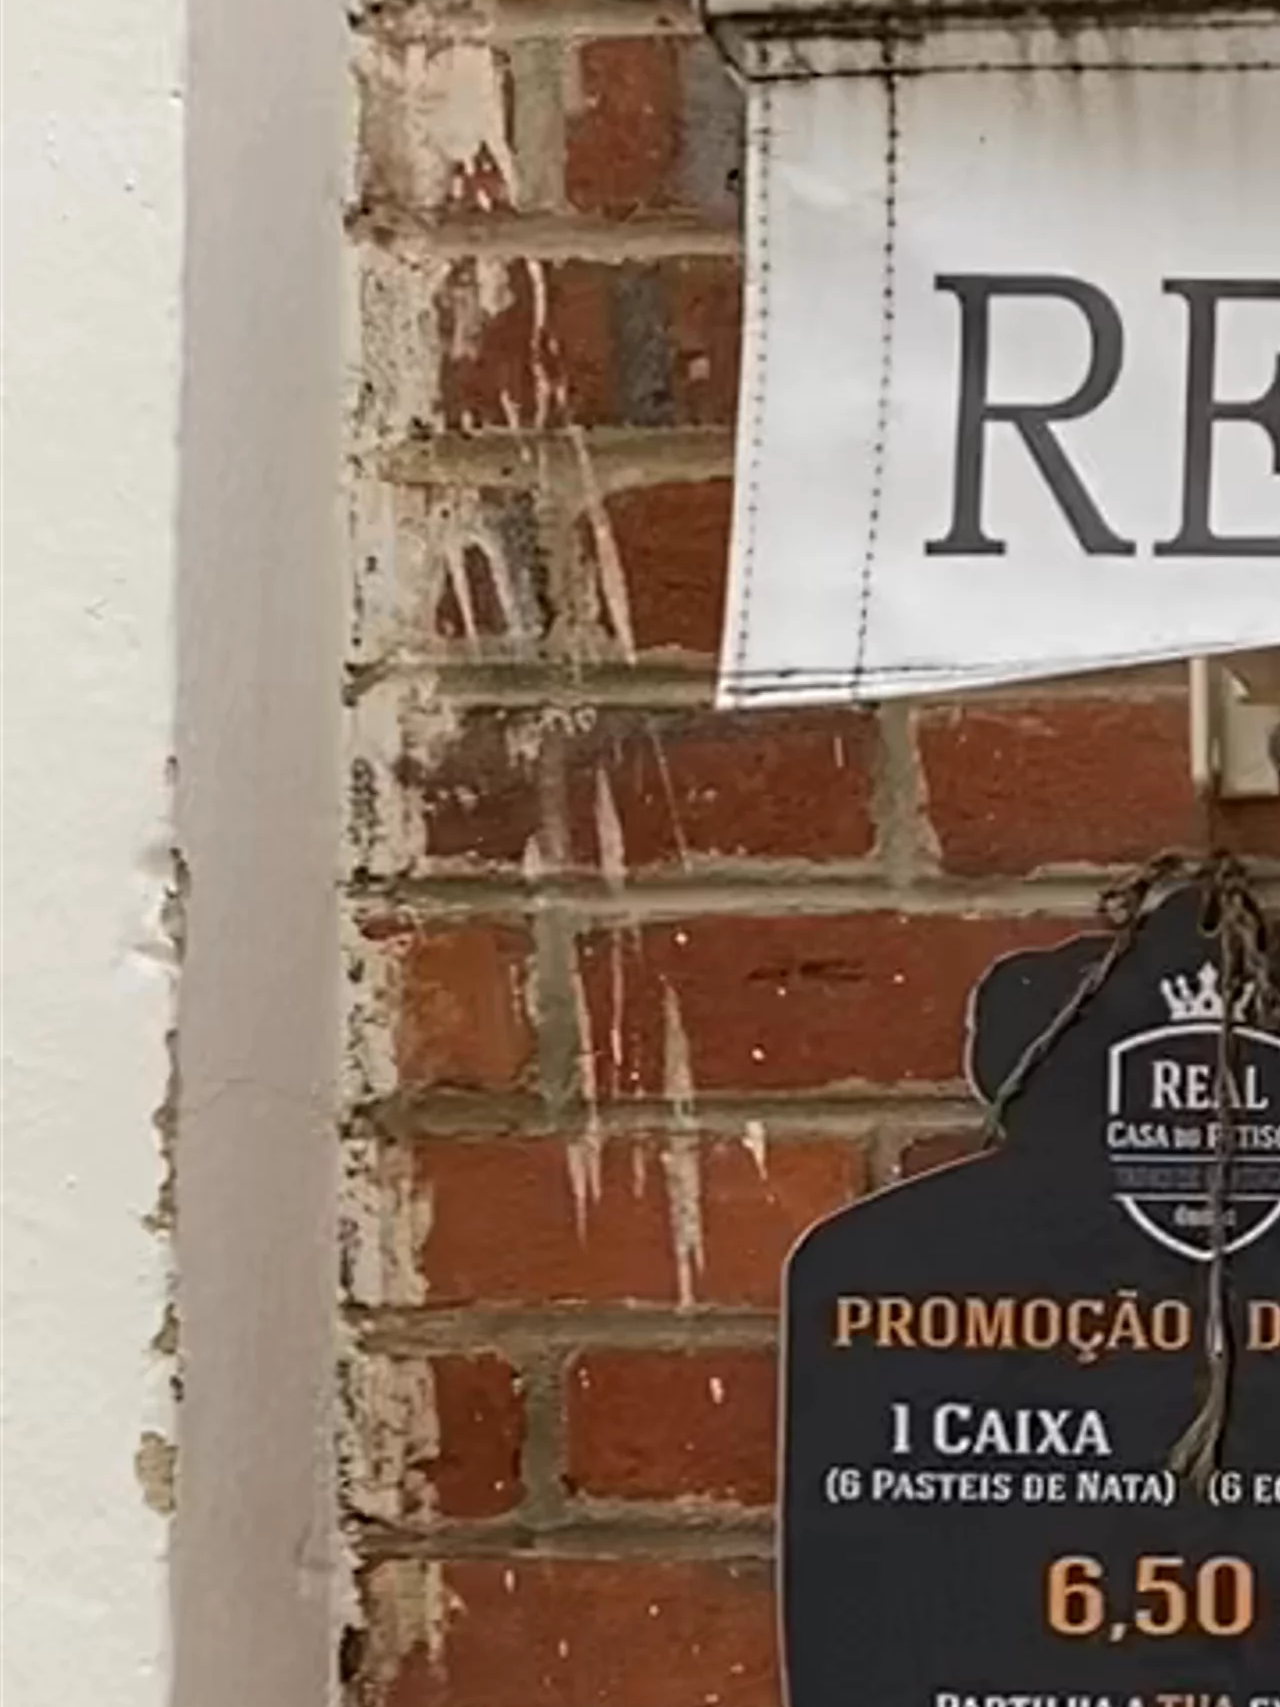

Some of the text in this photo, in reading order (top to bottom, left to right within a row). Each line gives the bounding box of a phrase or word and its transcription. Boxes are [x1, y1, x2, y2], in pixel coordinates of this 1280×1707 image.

[1150, 1059, 1269, 1110] REAL
[1107, 1121, 1170, 1148] CASA
[833, 1289, 1192, 1363] PROMOÇÃO
[891, 1402, 1113, 1455] 1 CAIXA
[825, 1467, 1176, 1505] (6 PASTEIS DE NATA)
[1208, 1470, 1242, 1506] (6
[1047, 1555, 1257, 1642] 6,50
